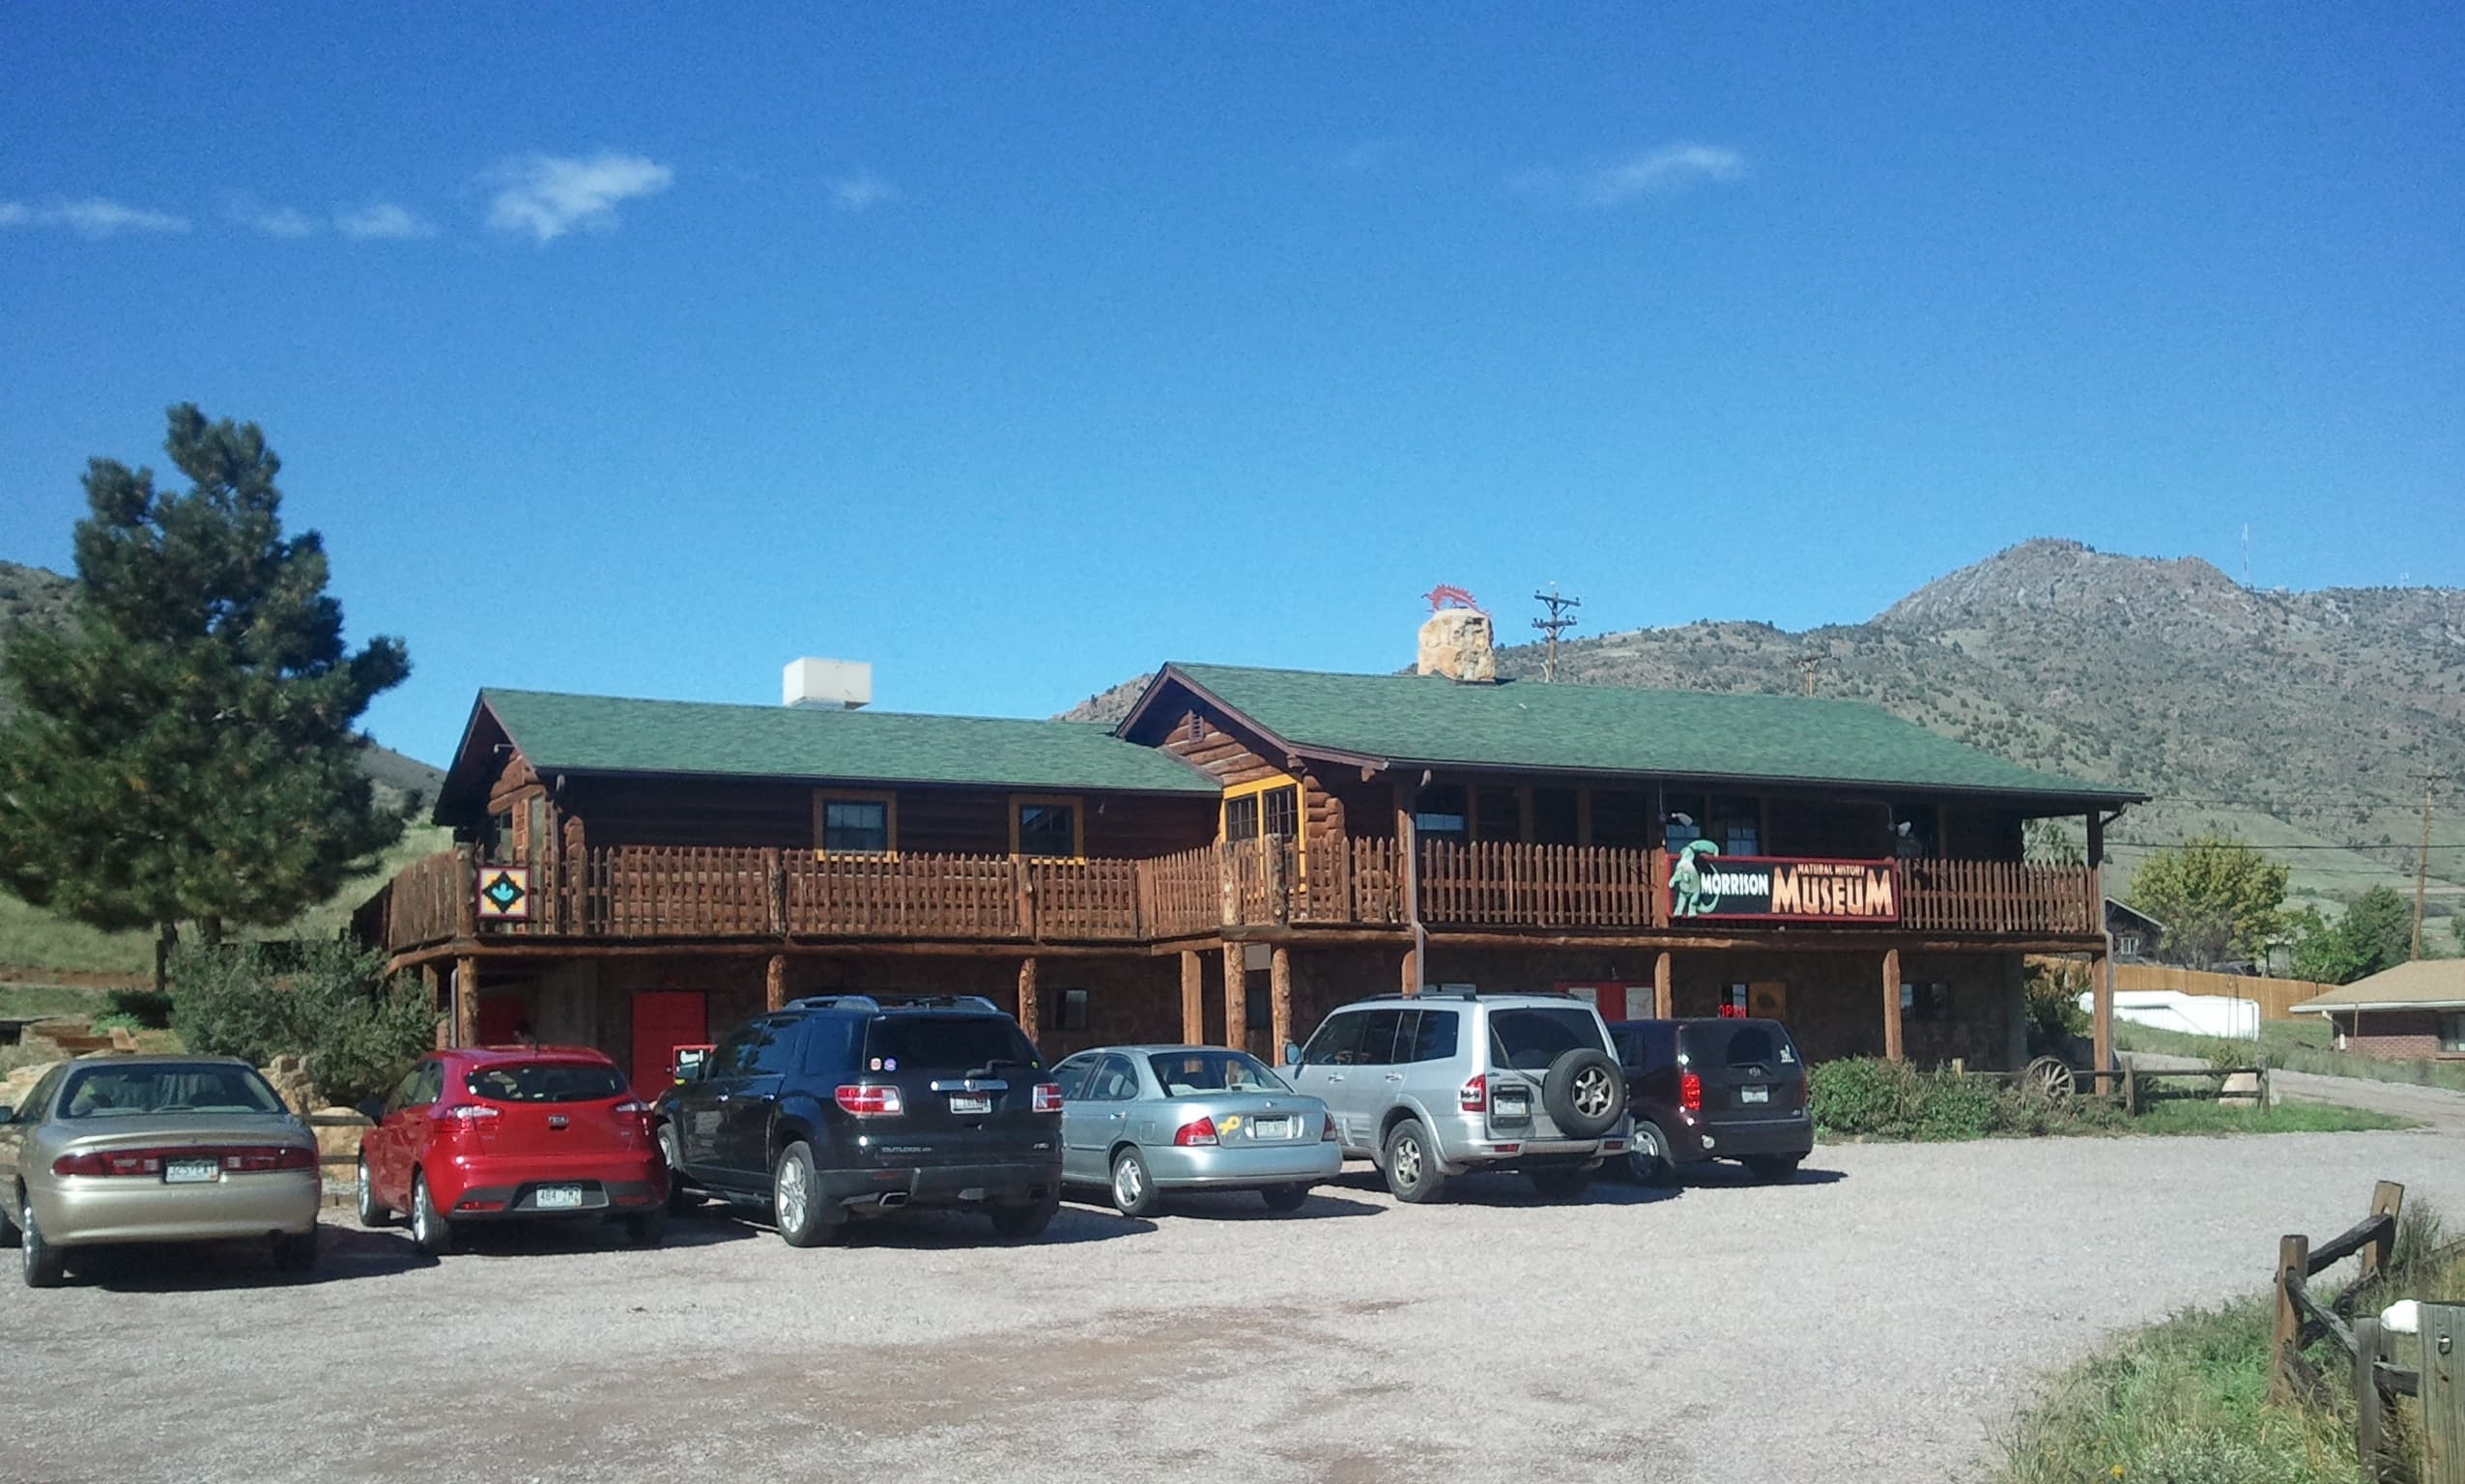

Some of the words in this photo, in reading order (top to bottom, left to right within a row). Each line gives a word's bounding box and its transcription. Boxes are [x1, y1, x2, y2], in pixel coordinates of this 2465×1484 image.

[1797, 863, 1833, 875] NATURAL
[1834, 864, 1865, 876] HISTORY
[1700, 872, 1769, 897] MORRISON
[1770, 866, 1894, 916] MUSEUM
